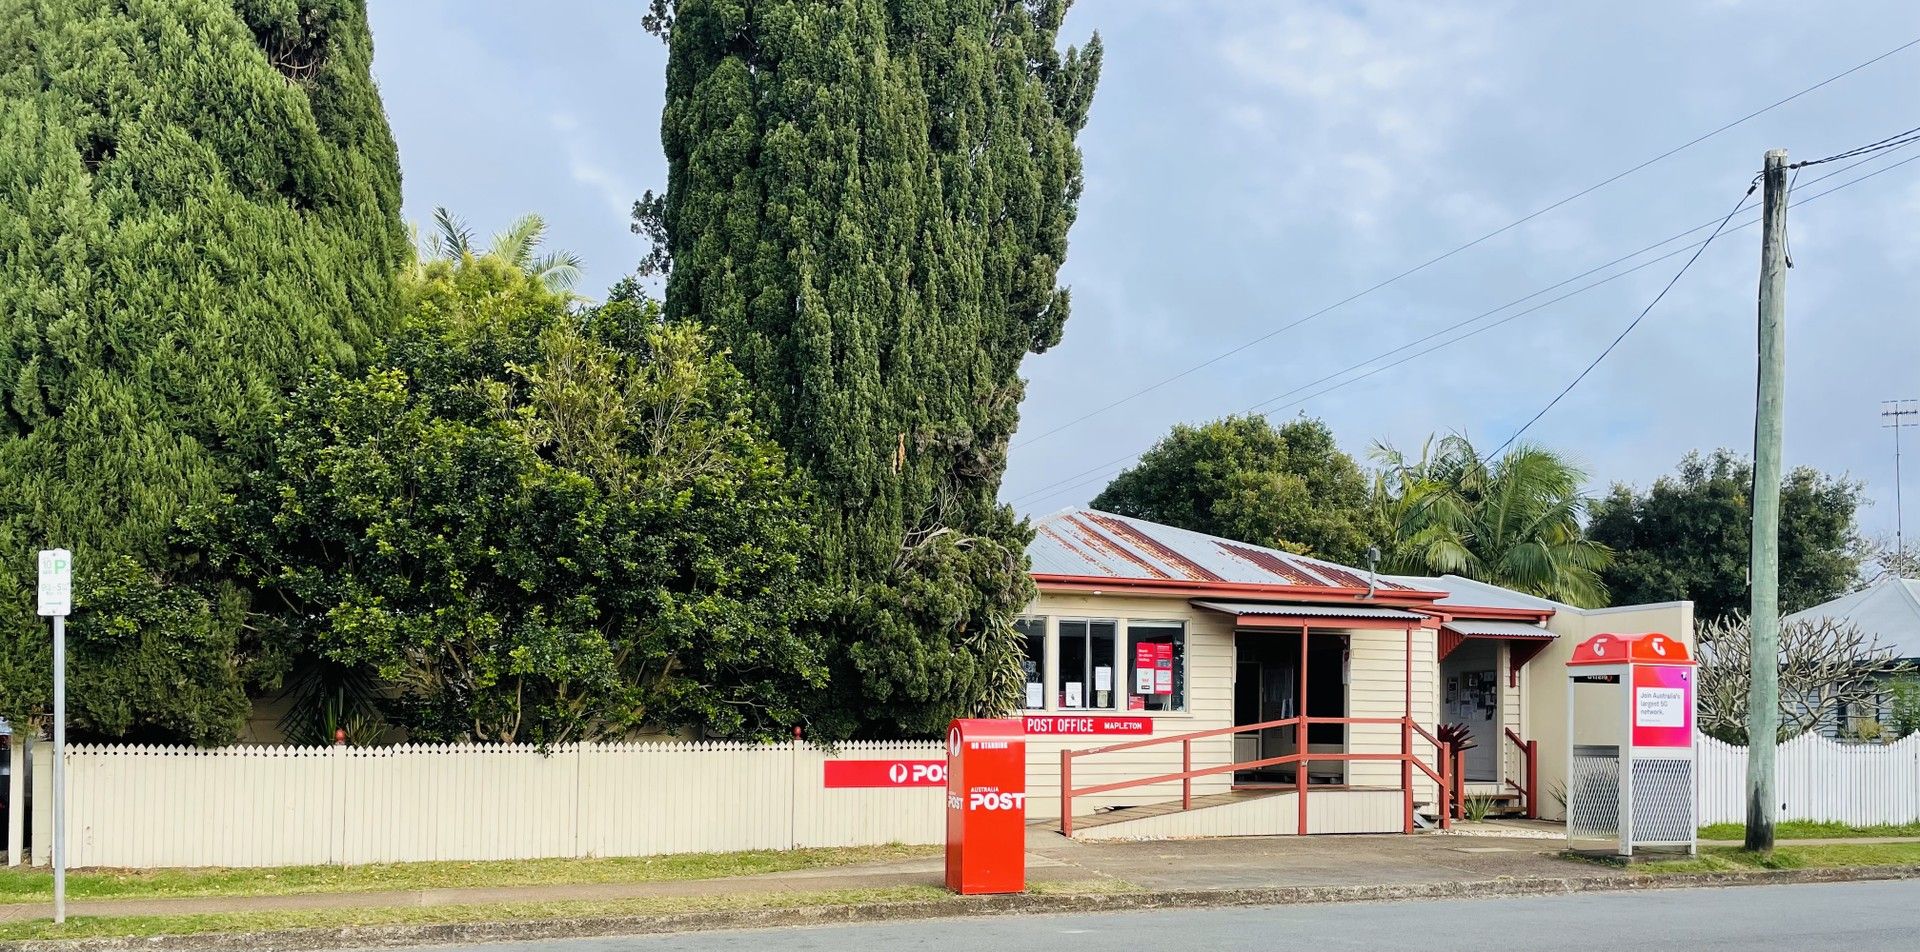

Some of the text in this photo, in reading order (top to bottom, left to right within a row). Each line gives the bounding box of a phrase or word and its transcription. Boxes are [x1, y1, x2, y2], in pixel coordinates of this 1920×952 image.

[55, 559, 66, 574] P
[1640, 700, 1659, 708] largest
[1027, 718, 1142, 732] POST OFFICE MAPLETON
[948, 795, 964, 810] POST
[970, 793, 1025, 811] POST
